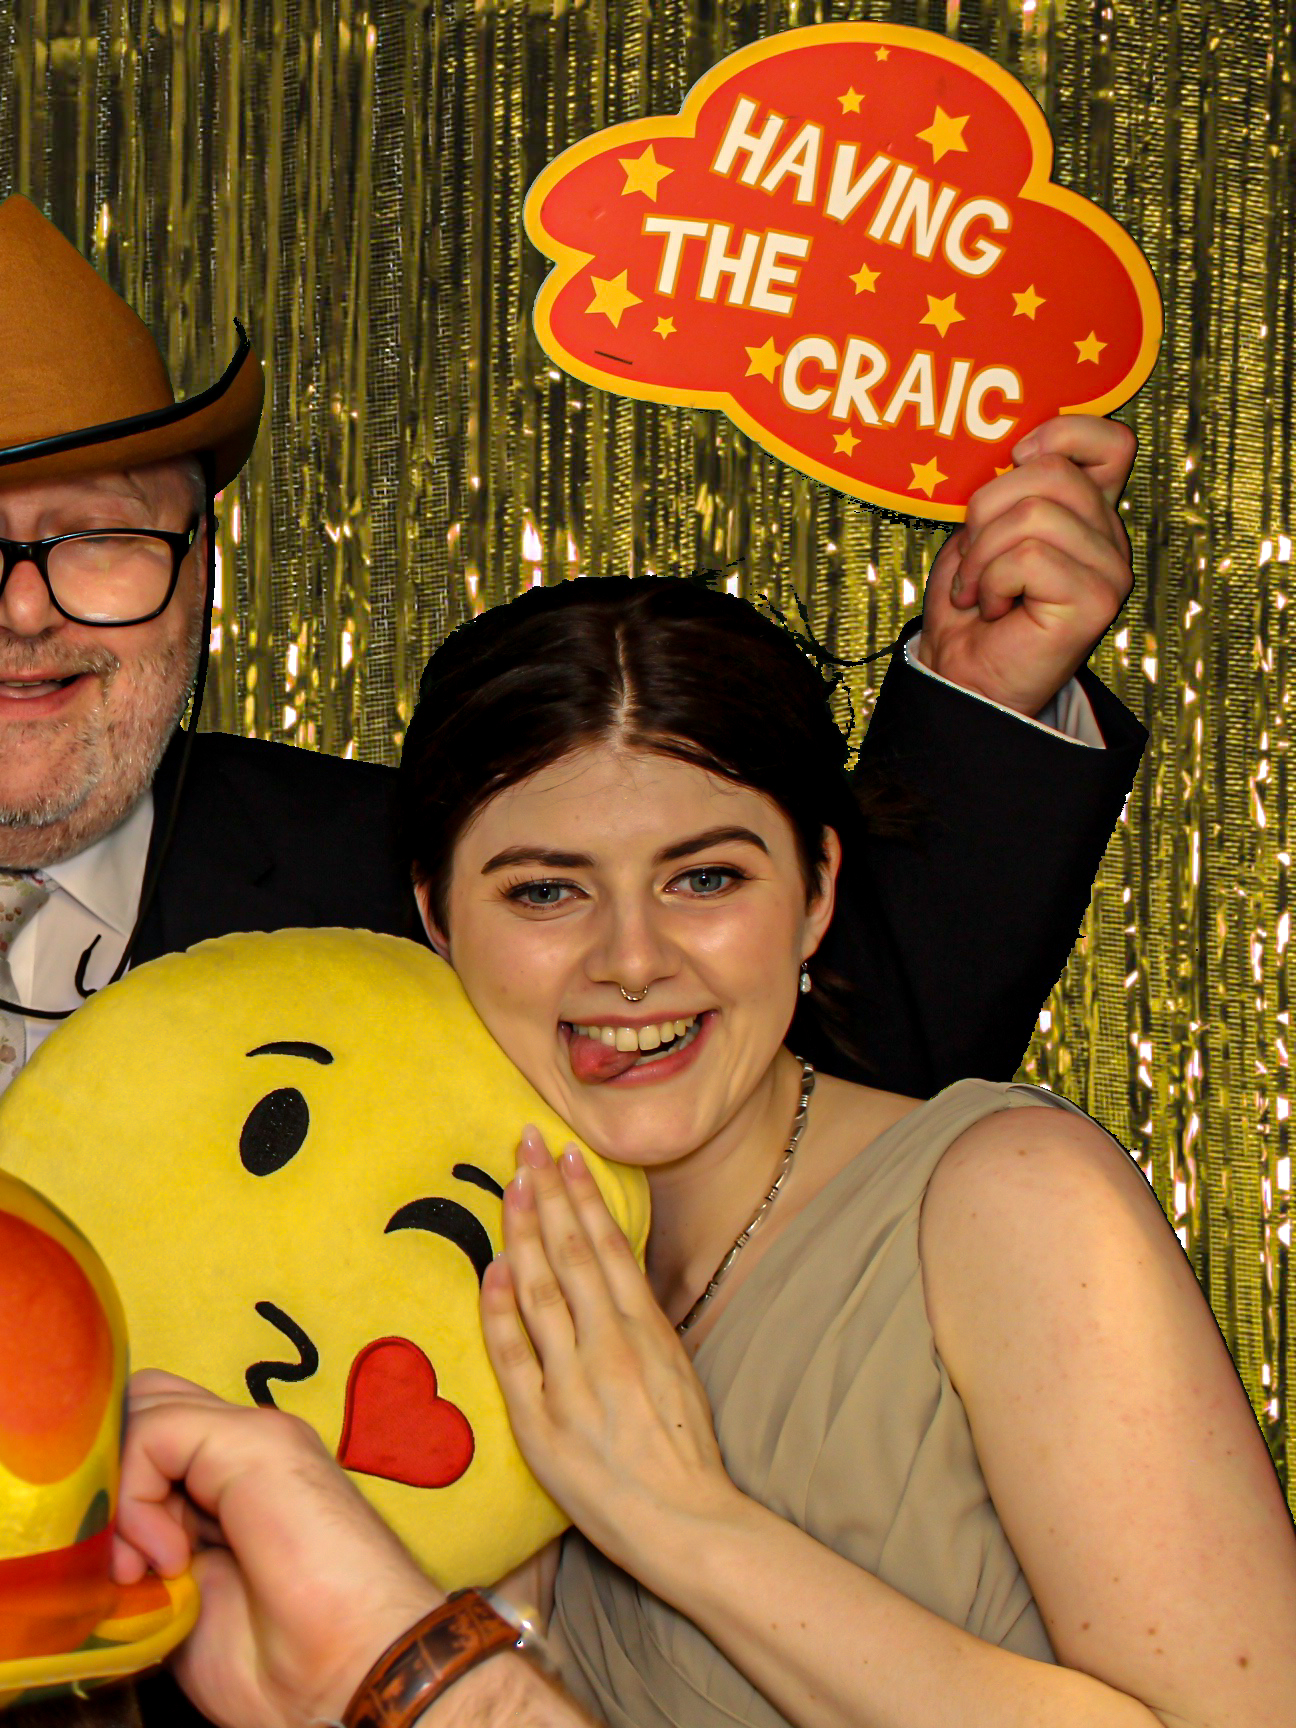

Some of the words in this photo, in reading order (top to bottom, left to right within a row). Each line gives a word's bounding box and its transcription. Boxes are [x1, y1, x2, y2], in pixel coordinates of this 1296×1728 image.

[711, 97, 1010, 277] HAVING
[644, 216, 809, 315] THE
[781, 336, 1022, 441] CRAIC
